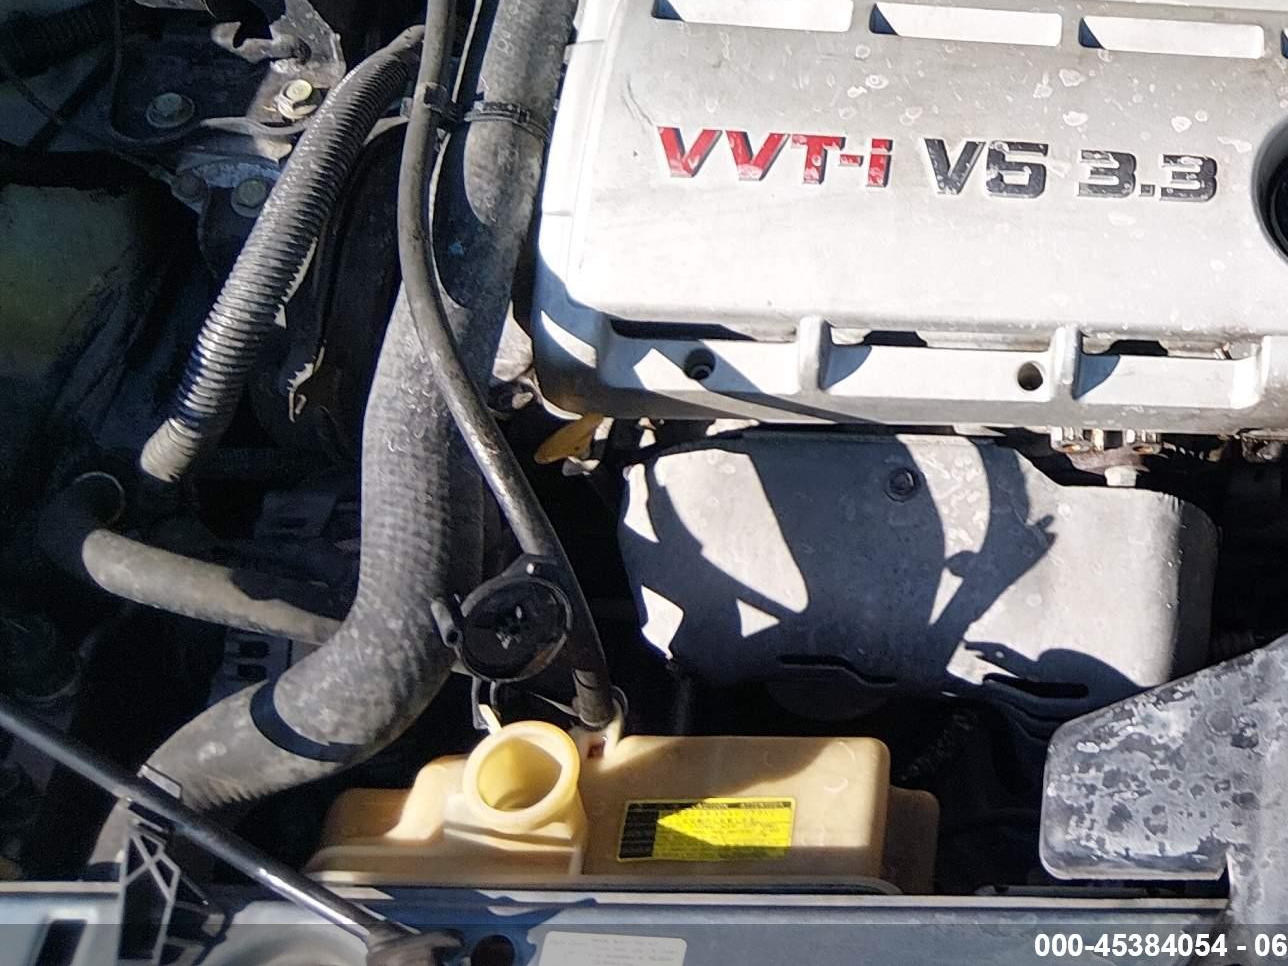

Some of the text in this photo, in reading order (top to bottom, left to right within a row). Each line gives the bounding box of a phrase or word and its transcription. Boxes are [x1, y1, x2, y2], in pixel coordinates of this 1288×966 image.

[655, 126, 1219, 203] VVT-i V6 3.3
